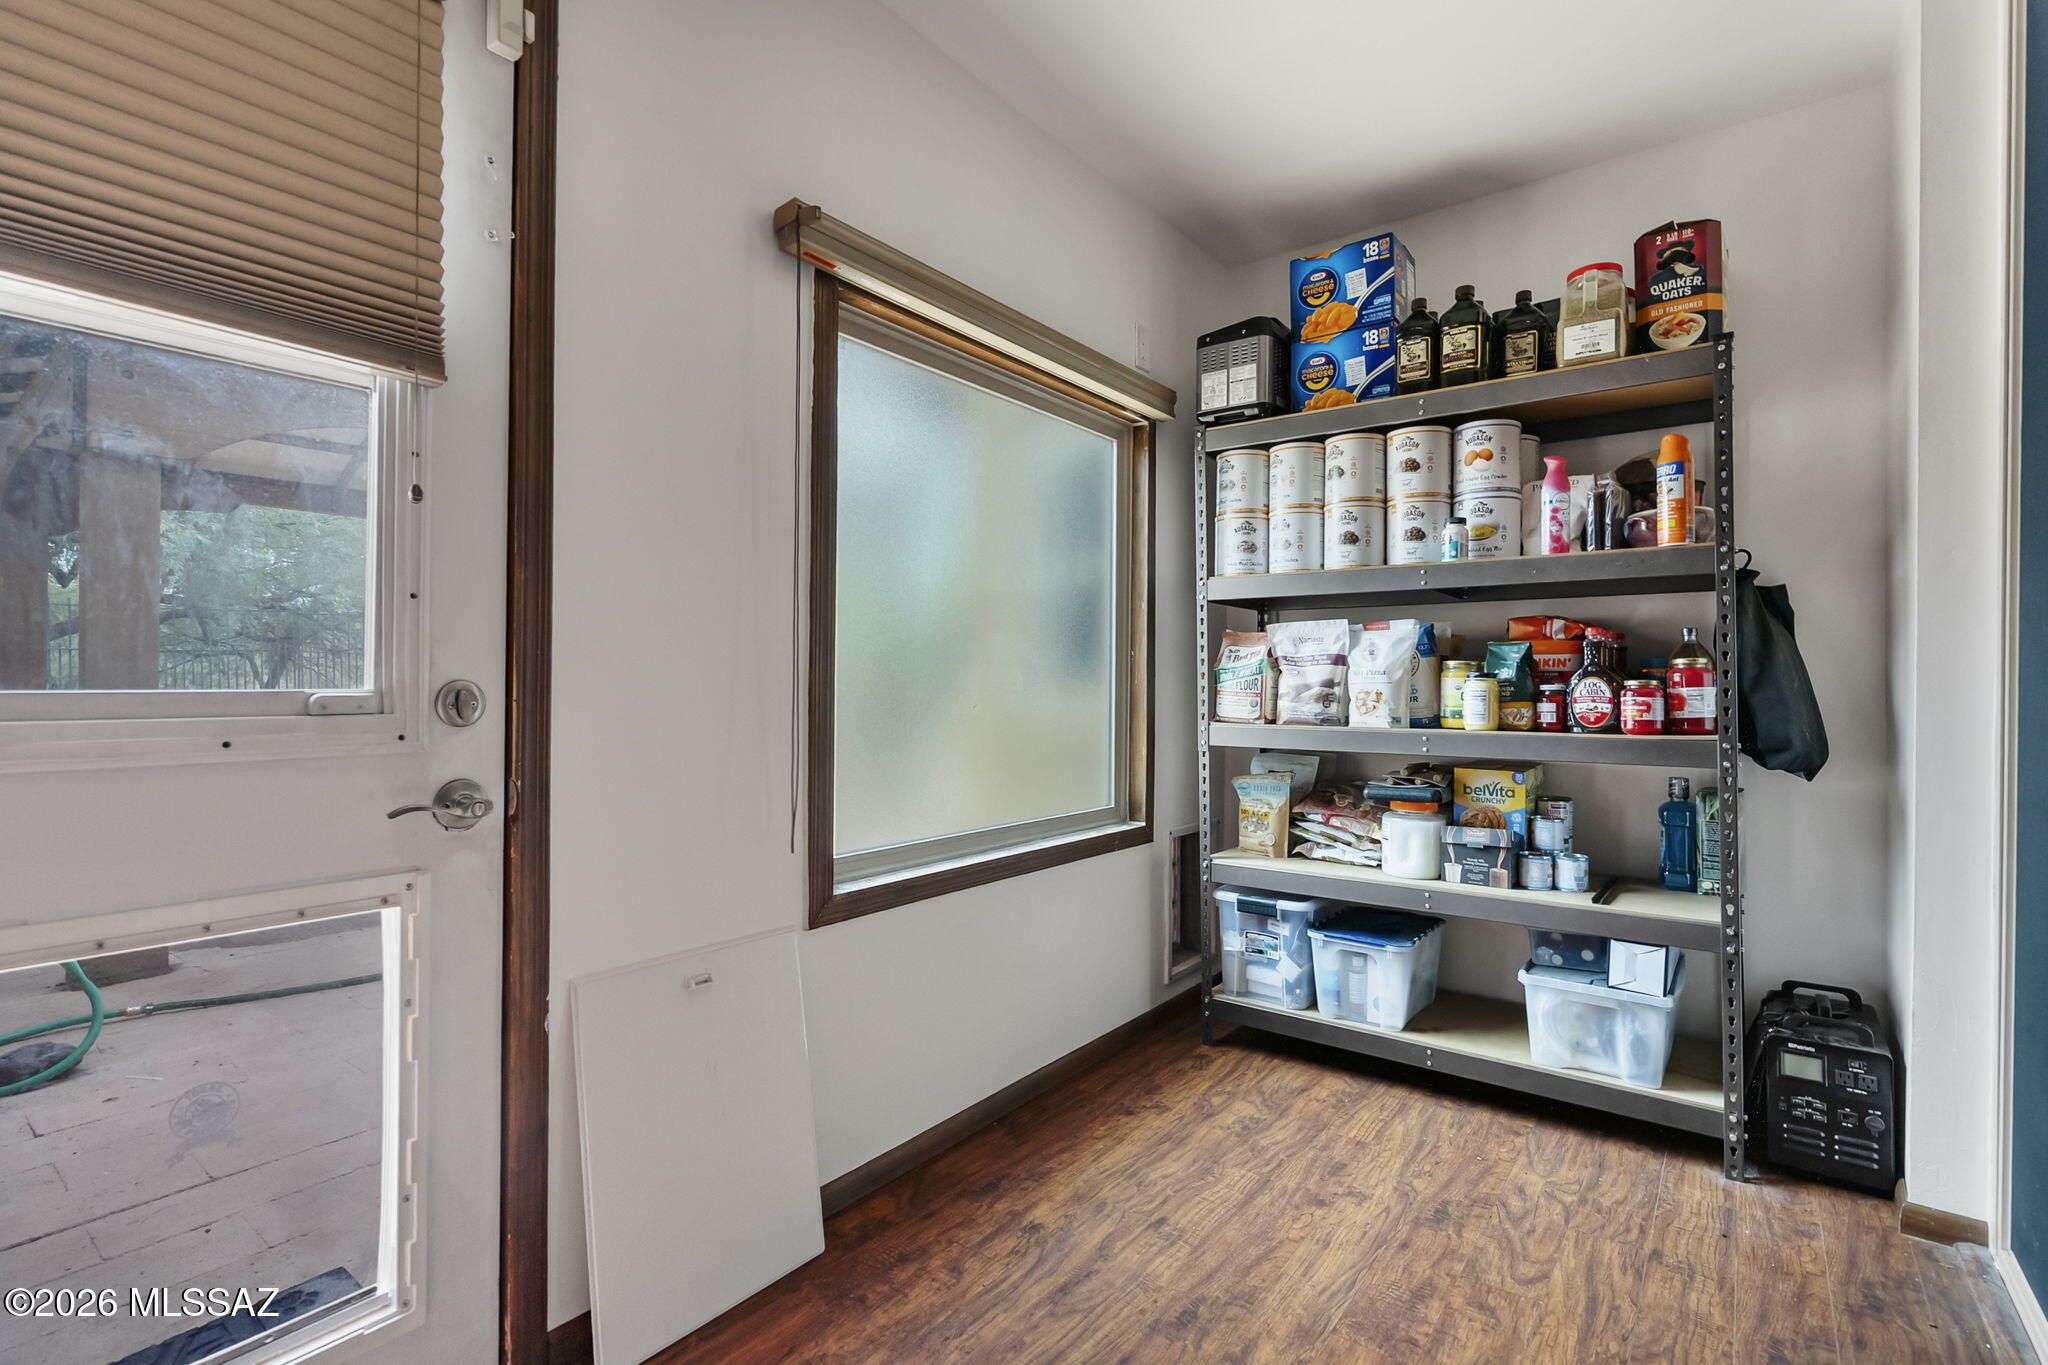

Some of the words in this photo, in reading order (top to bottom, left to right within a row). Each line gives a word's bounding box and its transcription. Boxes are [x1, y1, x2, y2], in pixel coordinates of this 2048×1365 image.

[1362, 240, 1379, 257] 18
[1302, 279, 1330, 291] macaroni
[1650, 275, 1703, 296] QUAKER
[1662, 286, 1692, 300] OATS
[1651, 308, 1664, 317] OLD
[1666, 300, 1703, 314] FASHIONED
[1362, 329, 1379, 346] 18
[1301, 365, 1330, 375] macaroni
[1366, 669, 1386, 677] Pizza
[1235, 677, 1260, 692] FLOUR
[1584, 680, 1602, 689] LOG
[1580, 688, 1606, 697] CABIN
[1463, 781, 1516, 798] belVita
[1471, 796, 1507, 805] CRUNCHY
